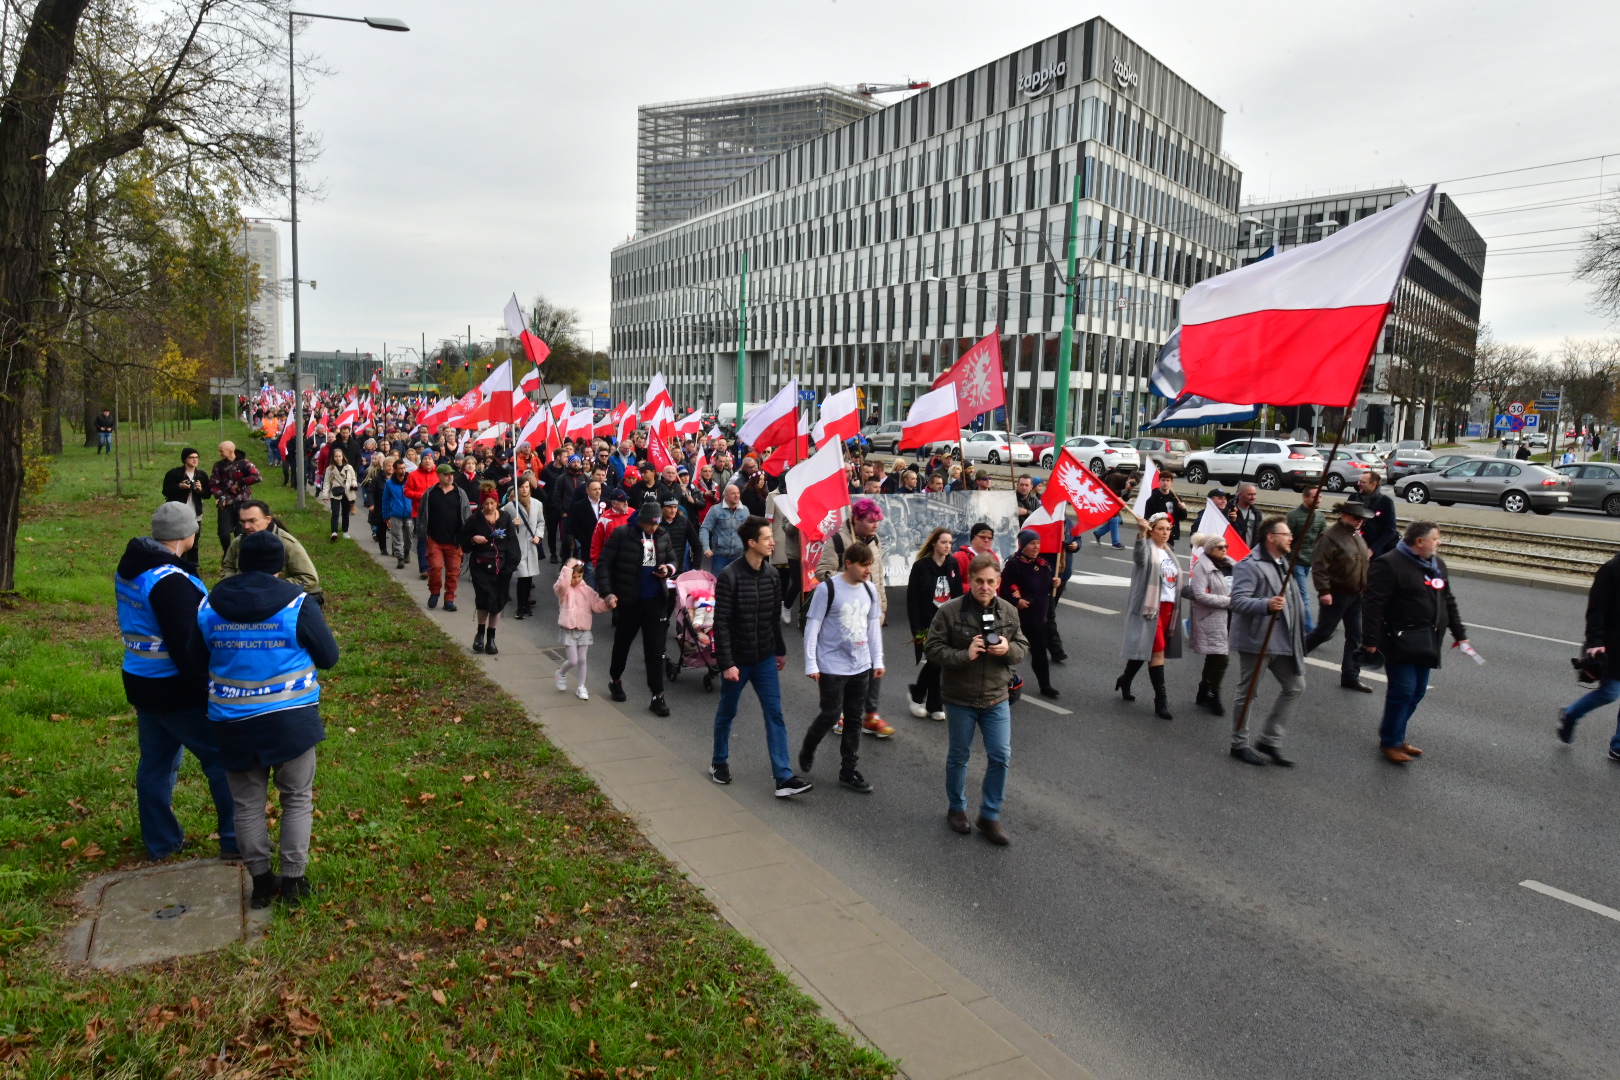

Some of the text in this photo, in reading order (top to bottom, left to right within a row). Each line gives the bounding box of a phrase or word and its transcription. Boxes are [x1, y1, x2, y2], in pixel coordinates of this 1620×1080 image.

[1018, 61, 1067, 91] żappka
[1112, 56, 1138, 87] żabka
[1511, 405, 1523, 413] 30
[1527, 417, 1535, 426] P
[213, 623, 279, 632] ANTYKONFLIKTOWY
[263, 640, 286, 648] TEAM
